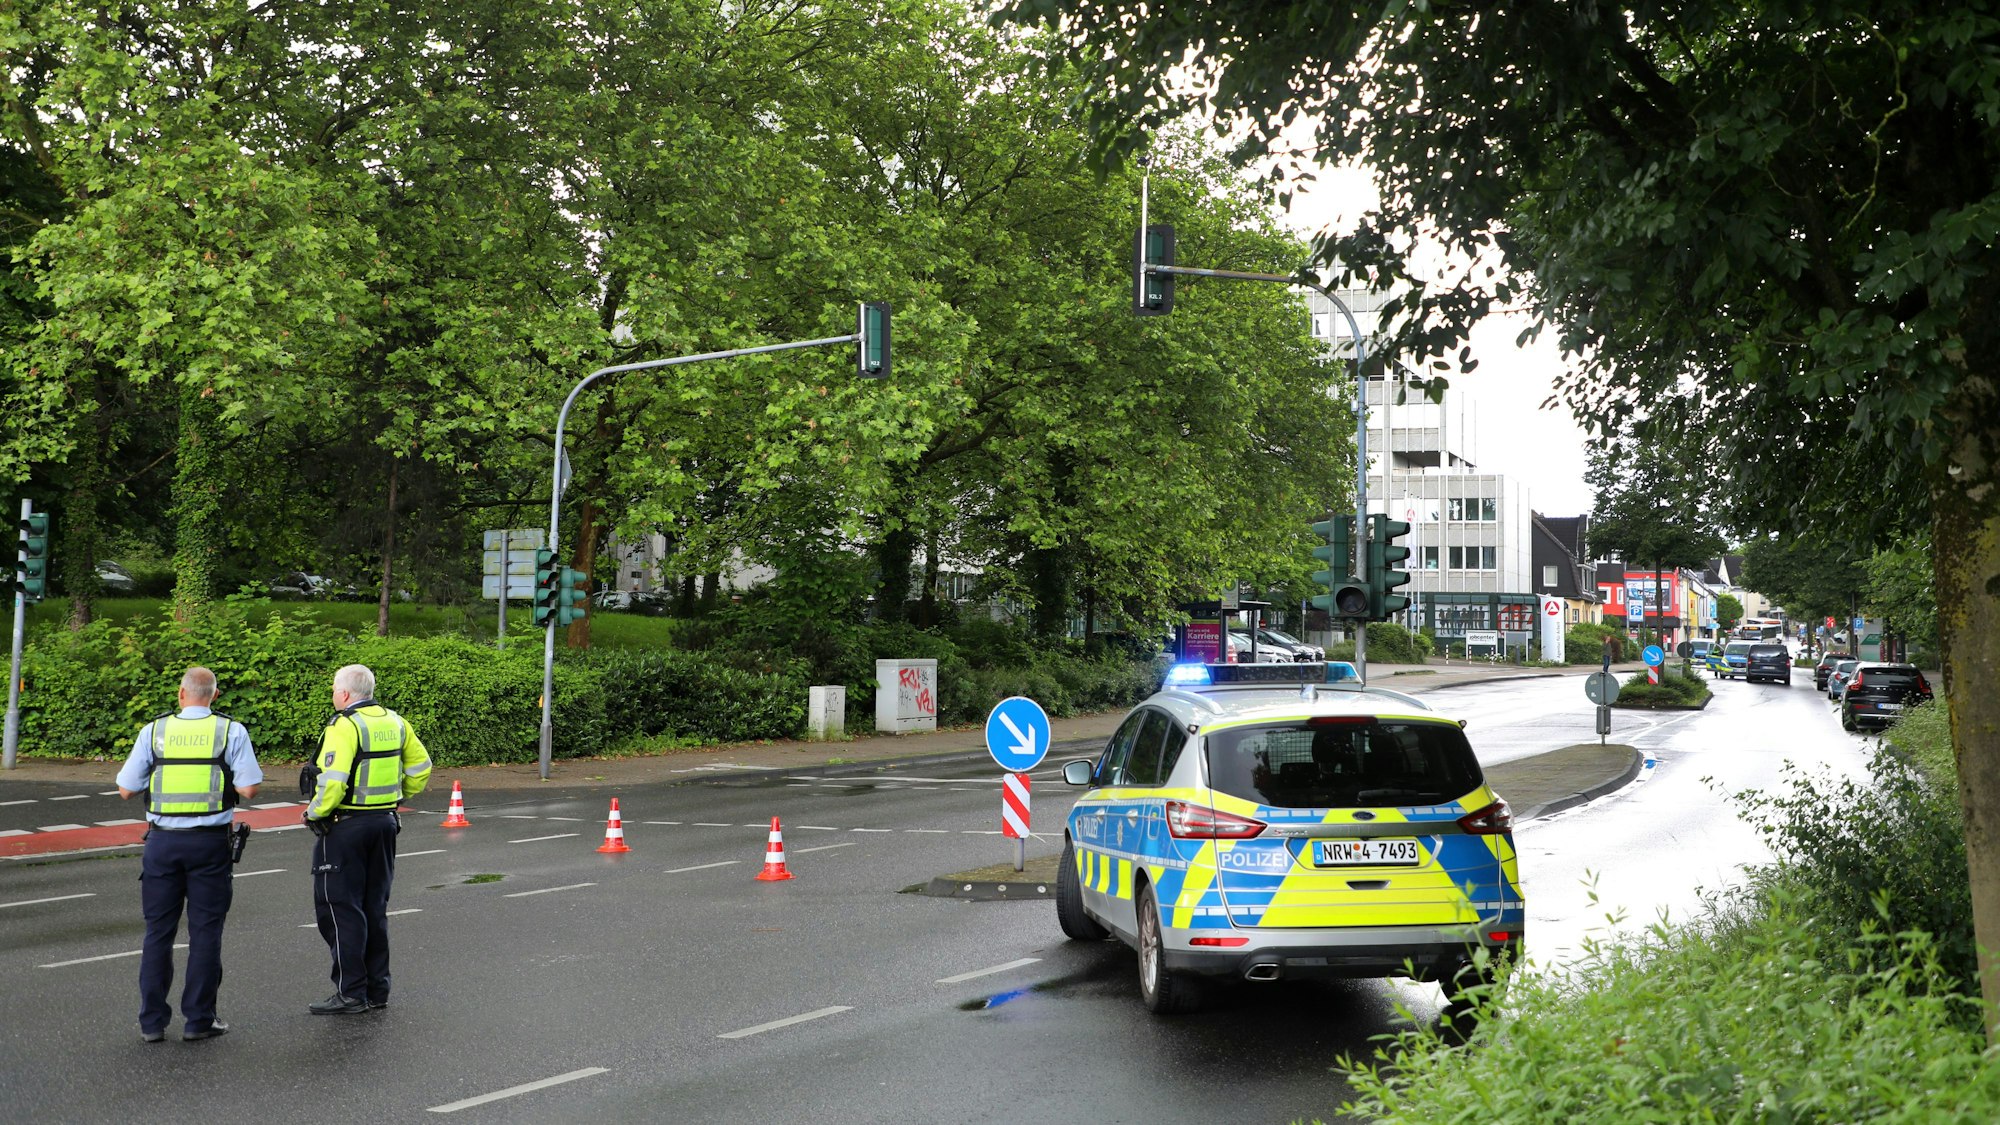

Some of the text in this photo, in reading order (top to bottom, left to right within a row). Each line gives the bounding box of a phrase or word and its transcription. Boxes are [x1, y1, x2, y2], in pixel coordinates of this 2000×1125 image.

[1187, 632, 1220, 640] Karriere
[169, 734, 209, 746] POLIZEI
[1082, 815, 1098, 839] POLIZEI
[1221, 852, 1288, 868] POLIZEI
[1323, 843, 1352, 861] NRW
